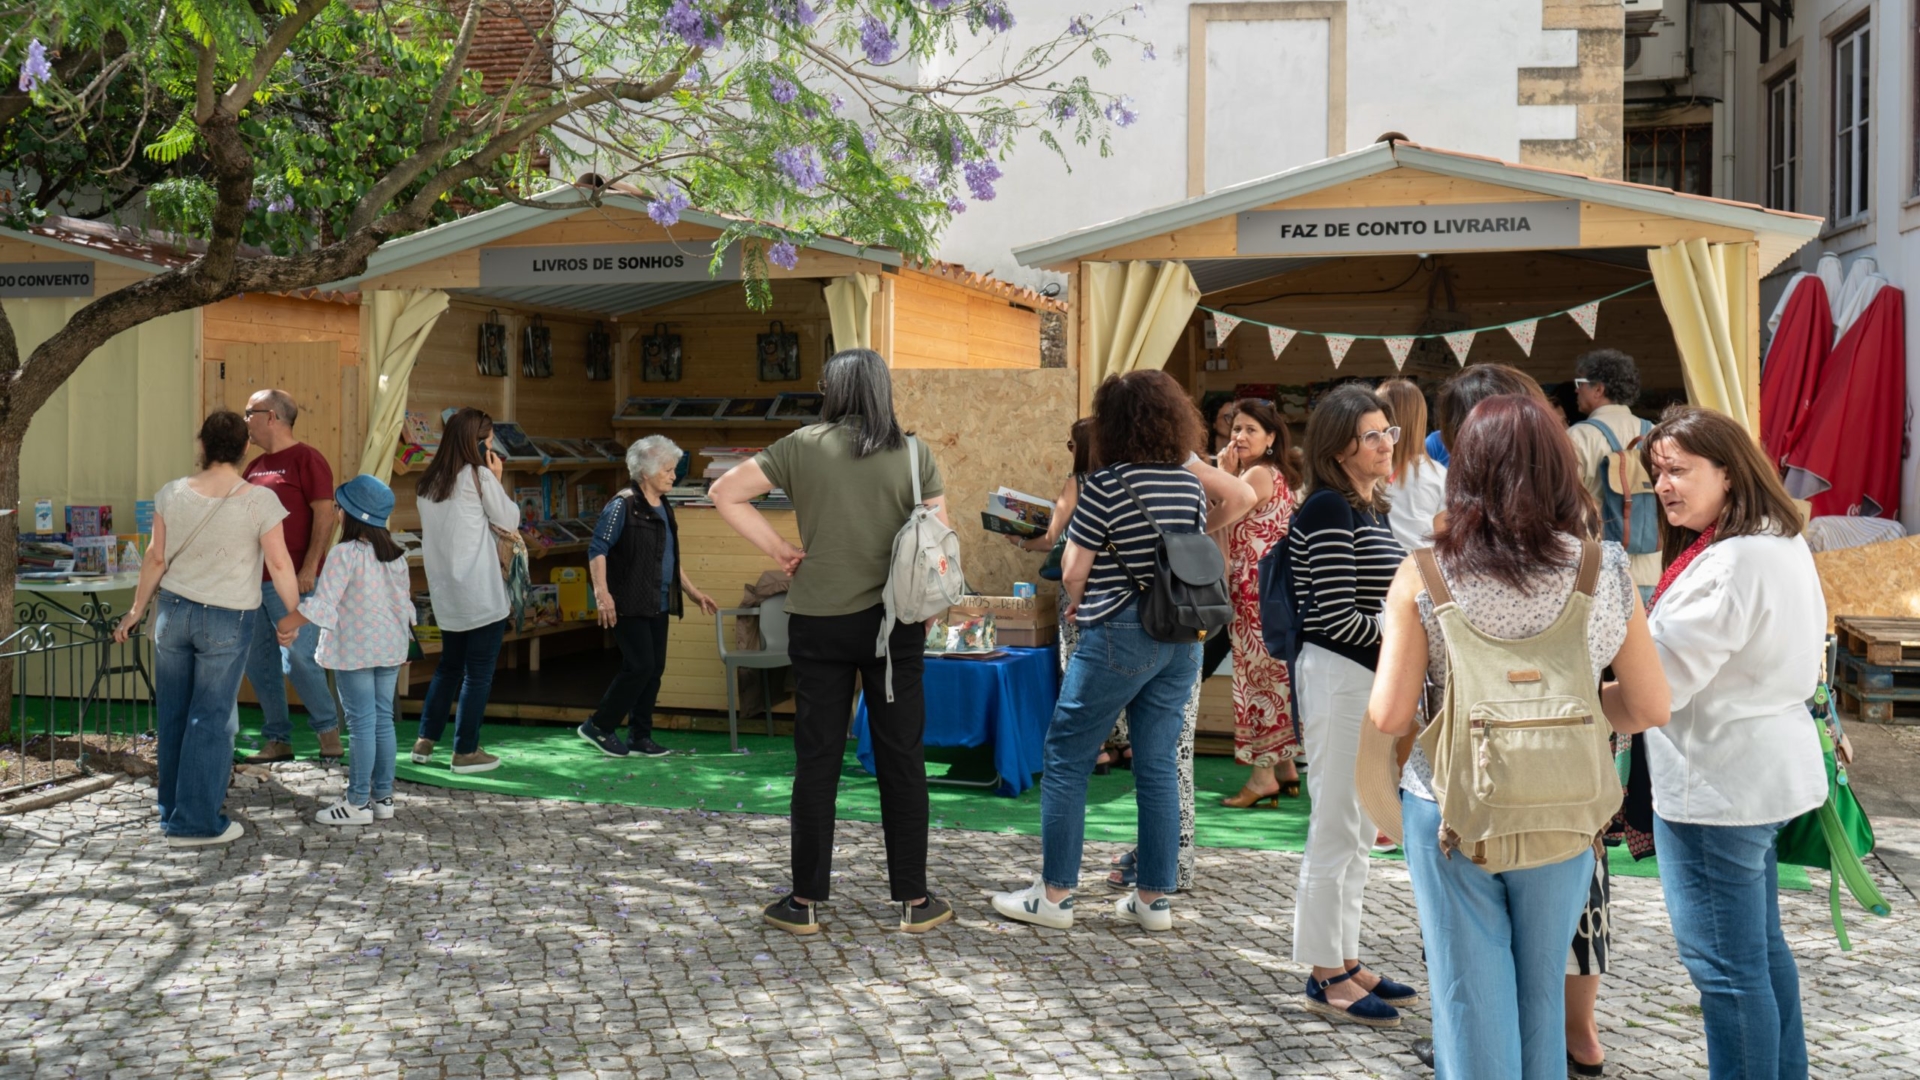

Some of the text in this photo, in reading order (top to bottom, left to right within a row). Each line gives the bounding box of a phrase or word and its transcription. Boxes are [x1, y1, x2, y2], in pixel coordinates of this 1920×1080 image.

[1281, 217, 1531, 238] FAZ DE CONTO LIVRARIA
[533, 255, 684, 271] LIVROS DE SONHOS
[18, 274, 89, 287] CONVENTO
[960, 596, 990, 609] VROS
